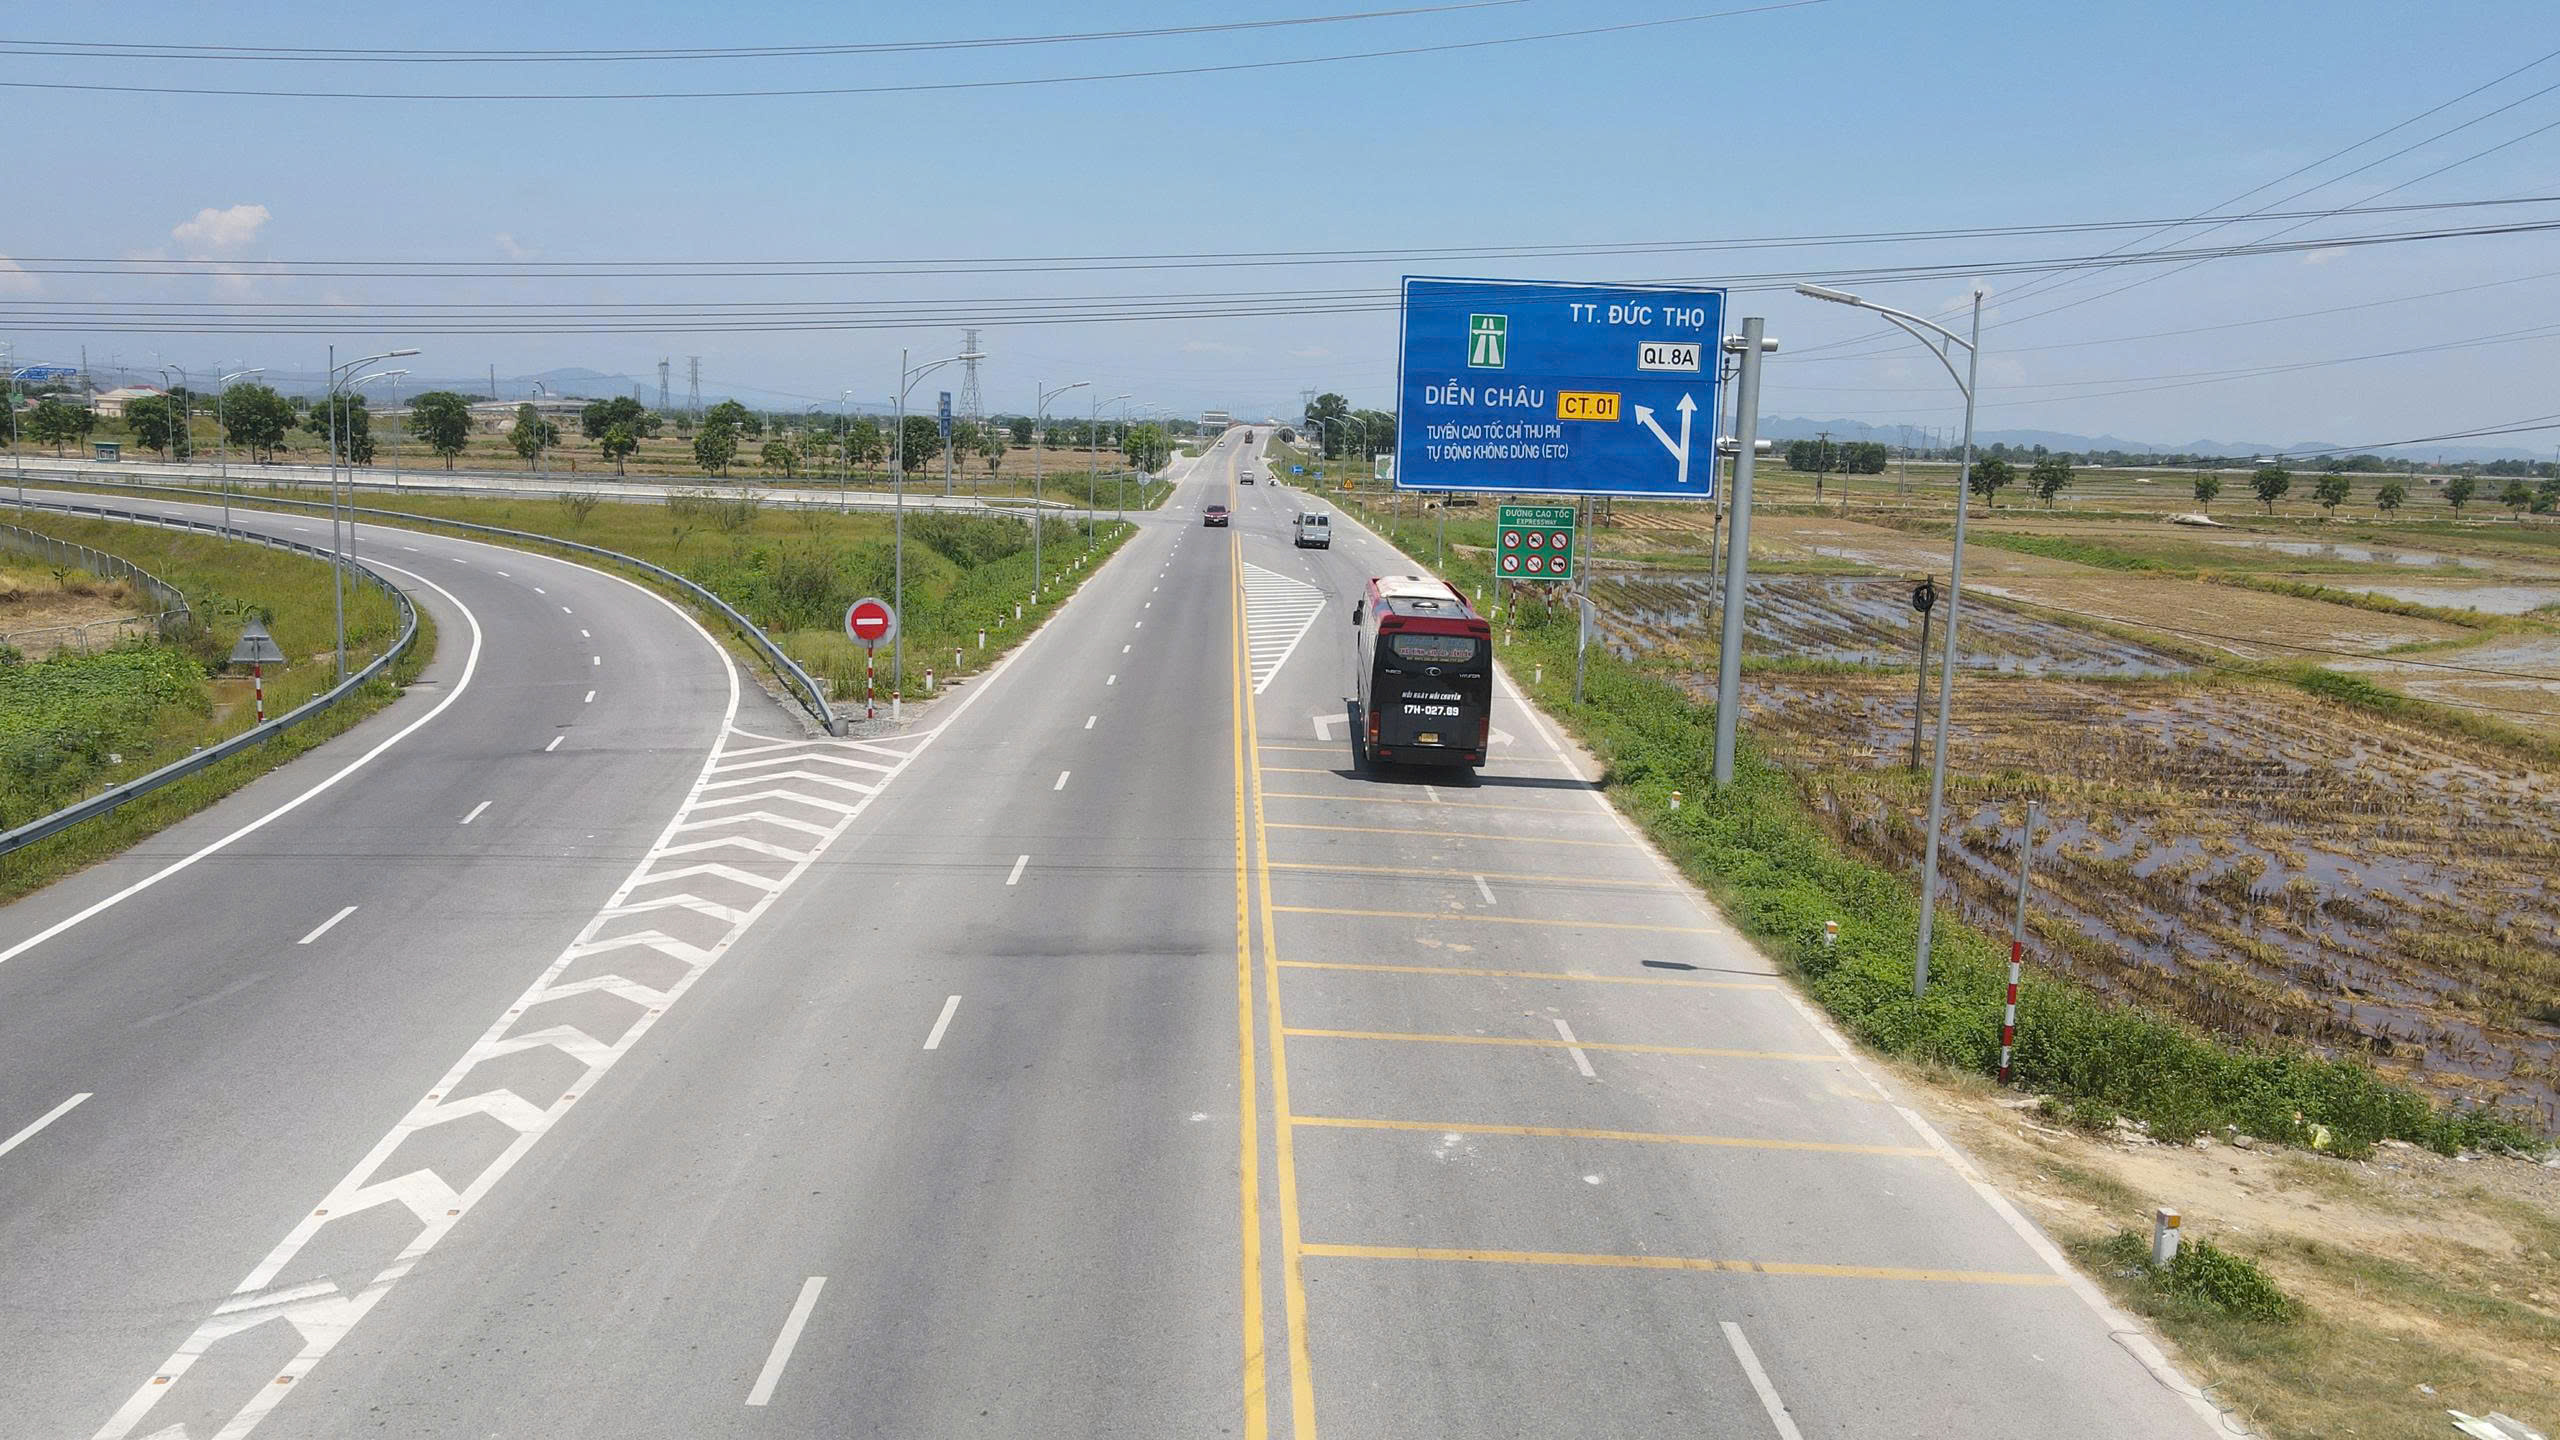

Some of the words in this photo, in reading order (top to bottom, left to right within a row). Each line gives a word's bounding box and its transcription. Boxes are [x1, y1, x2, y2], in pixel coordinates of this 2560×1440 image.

[1570, 303, 1600, 324] TT.
[1608, 299, 1652, 326] ĐỨC
[1662, 306, 1705, 332] THỌ
[1644, 347, 1694, 366] QL.8A
[1425, 377, 1475, 406] DIỄN
[1484, 384, 1545, 408] CHÂU
[1427, 419, 1460, 440] TUYẾN
[1461, 424, 1481, 440] CAO
[1484, 419, 1503, 440] TỐC
[1505, 419, 1523, 440] CHỈ
[1524, 424, 1544, 439] THU
[1545, 421, 1564, 439] PHÍ
[1427, 444, 1442, 463] TỰ
[1444, 442, 1471, 463] ĐỘNG
[1473, 441, 1509, 460] KHÔNG
[1510, 440, 1540, 460] DỪNG
[1542, 442, 1569, 460] (ETC)
[1516, 518, 1557, 526] EXPRESSWAY
[1535, 510, 1552, 518] CAO
